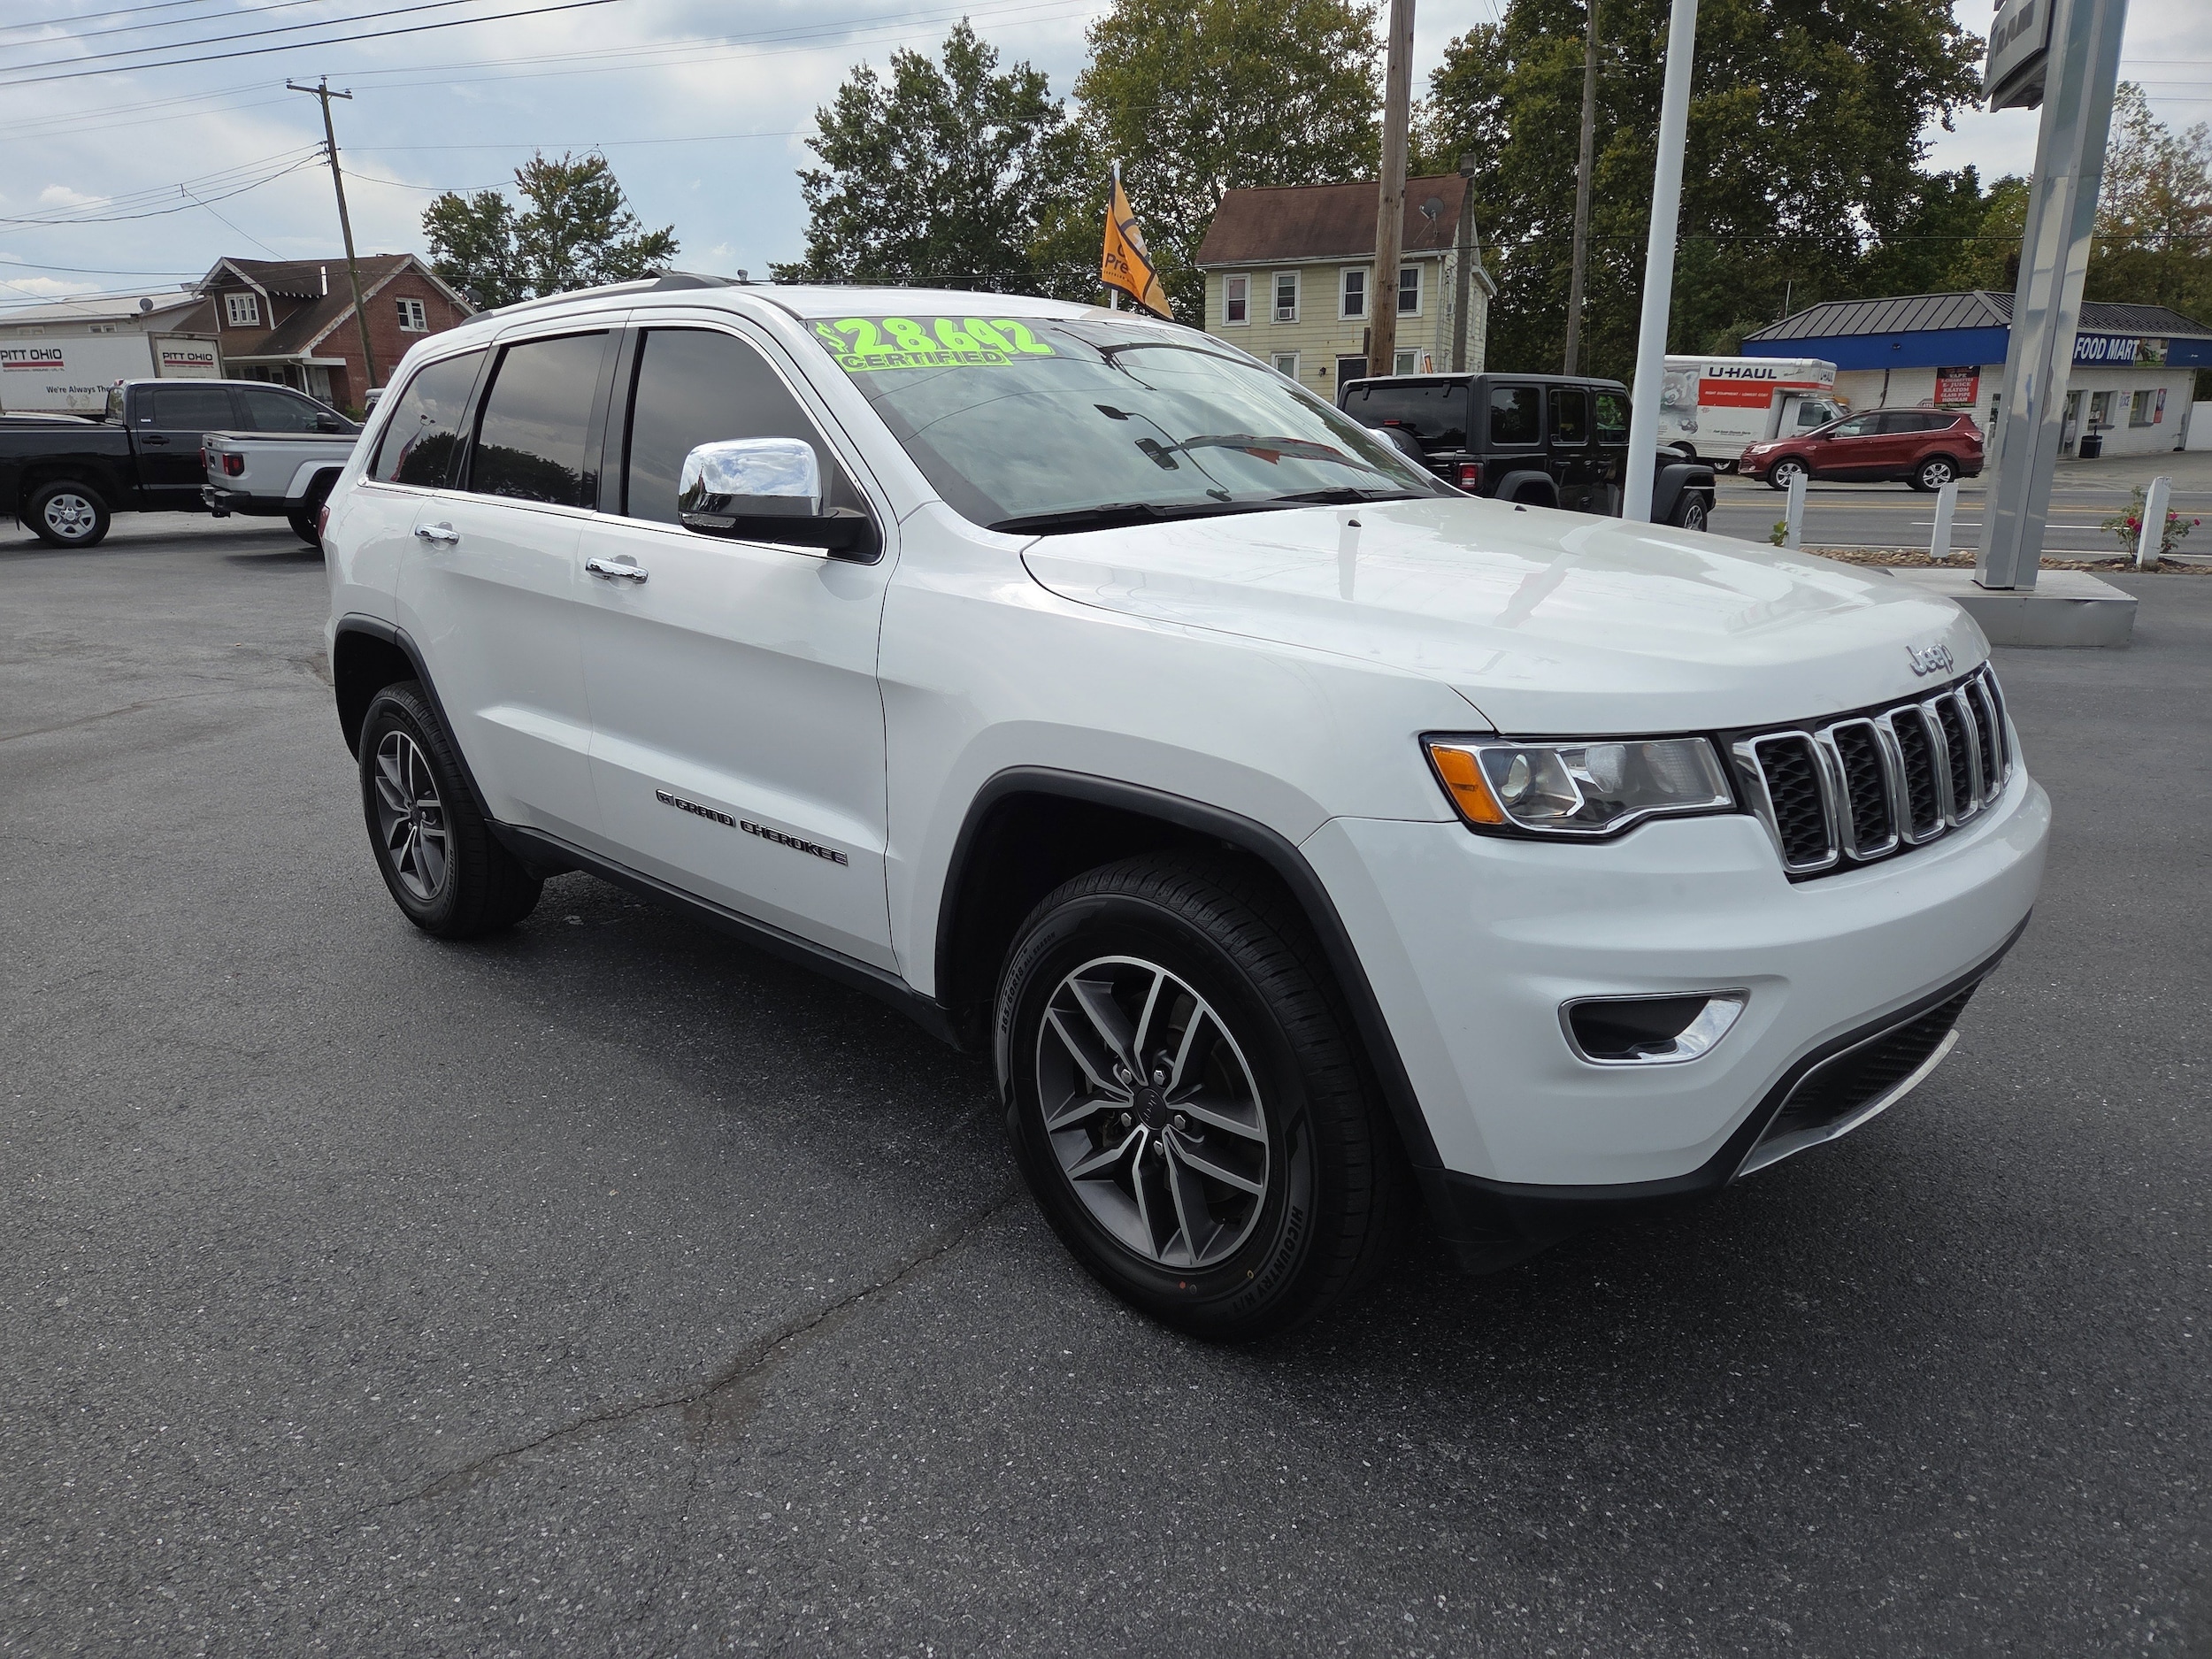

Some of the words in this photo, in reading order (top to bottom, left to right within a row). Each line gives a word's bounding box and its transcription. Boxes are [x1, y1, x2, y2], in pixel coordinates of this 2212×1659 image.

[0, 349, 27, 360] PITT
[30, 349, 63, 360] OHIO
[2073, 336, 2108, 359] FOOD
[2106, 338, 2140, 361] MART
[841, 352, 1006, 369] CERTIFIED
[1709, 366, 1778, 380] U-HAUL
[68, 386, 96, 395] Always
[1905, 644, 1955, 677] Jeep
[674, 796, 737, 828] GRAND
[739, 817, 849, 867] CHEROKEE
[1256, 1205, 1304, 1298] HICOUNTRY
